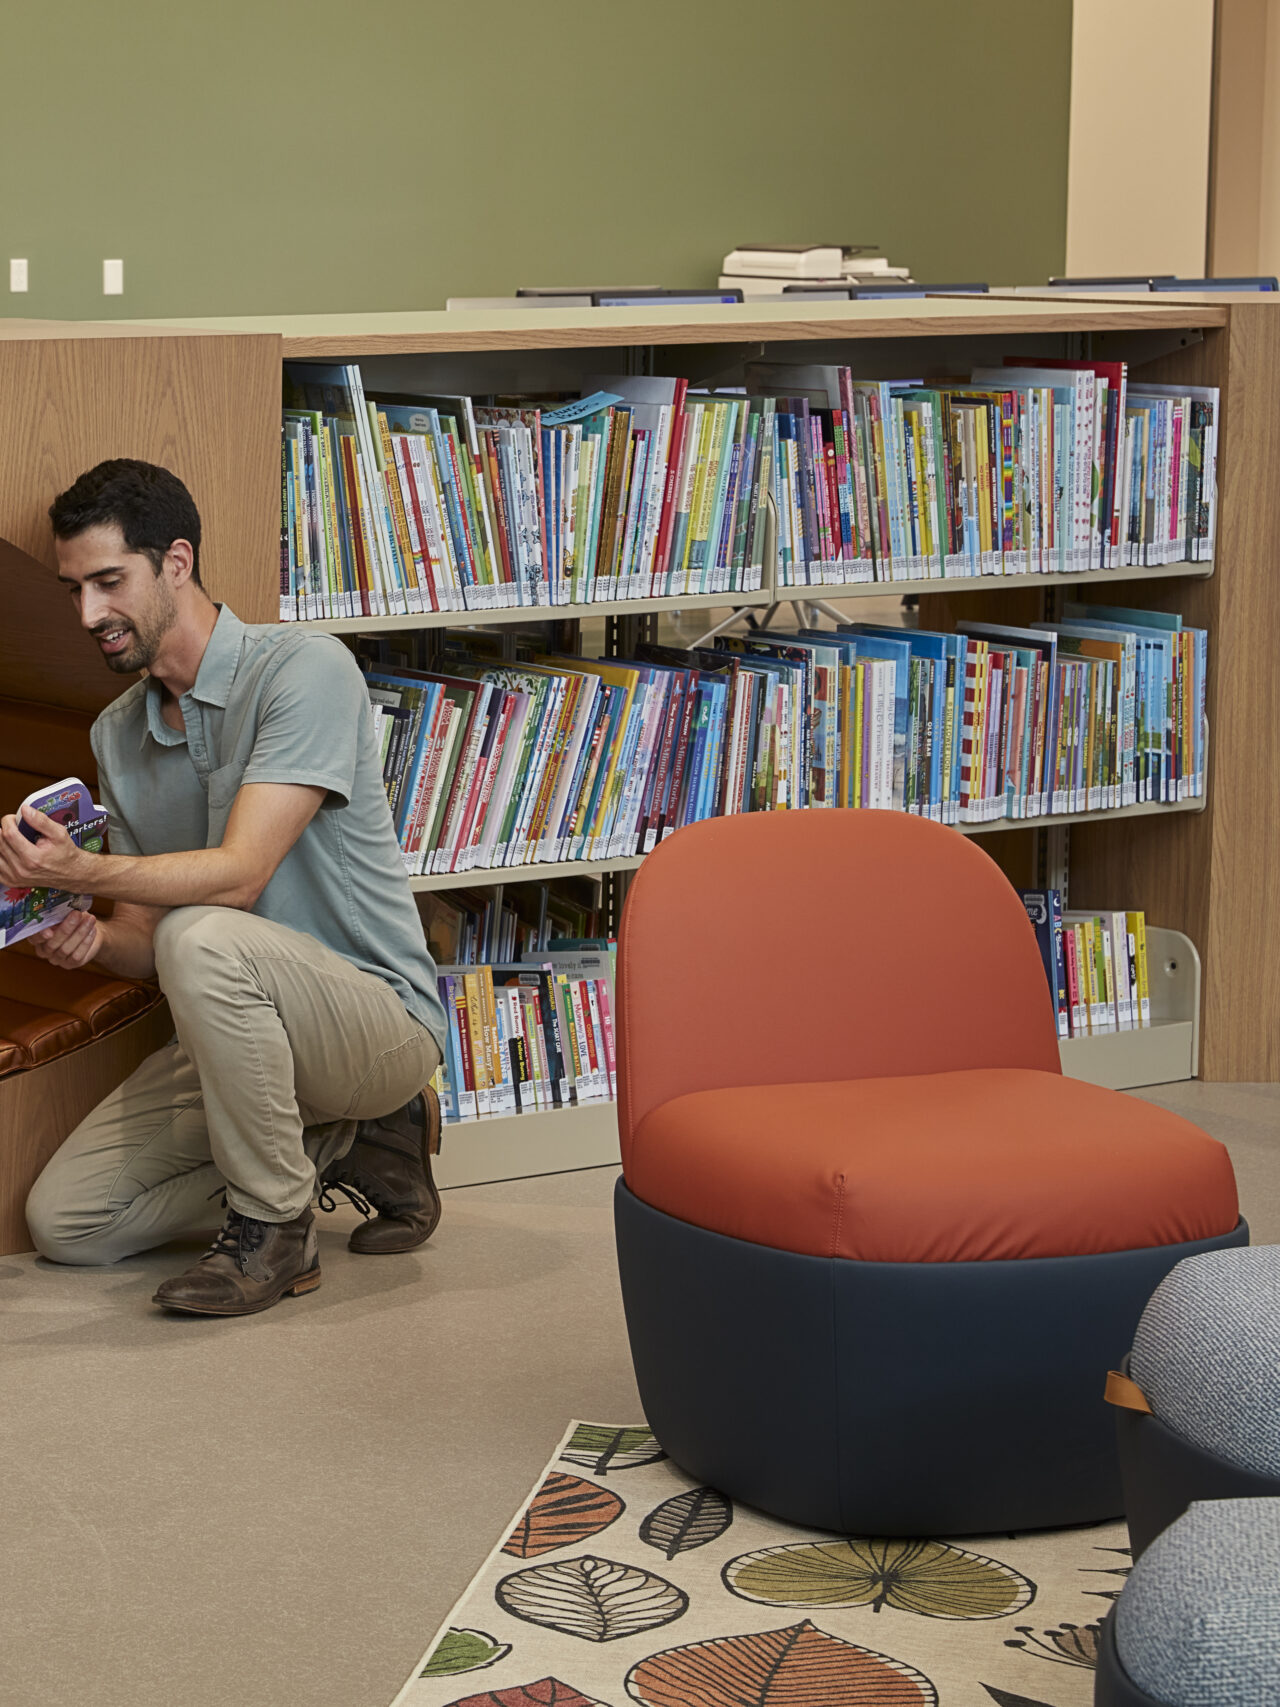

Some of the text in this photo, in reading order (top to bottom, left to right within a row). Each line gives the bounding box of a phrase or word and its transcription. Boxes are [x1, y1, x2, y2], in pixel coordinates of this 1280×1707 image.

[659, 738, 672, 779] 5-Minute
[653, 781, 665, 812] Stories
[491, 1026, 499, 1054] Bedtime
[513, 1015, 521, 1034] Bunny
[483, 1025, 494, 1071] How Many?
[516, 1040, 527, 1081] Yellow Bunny
